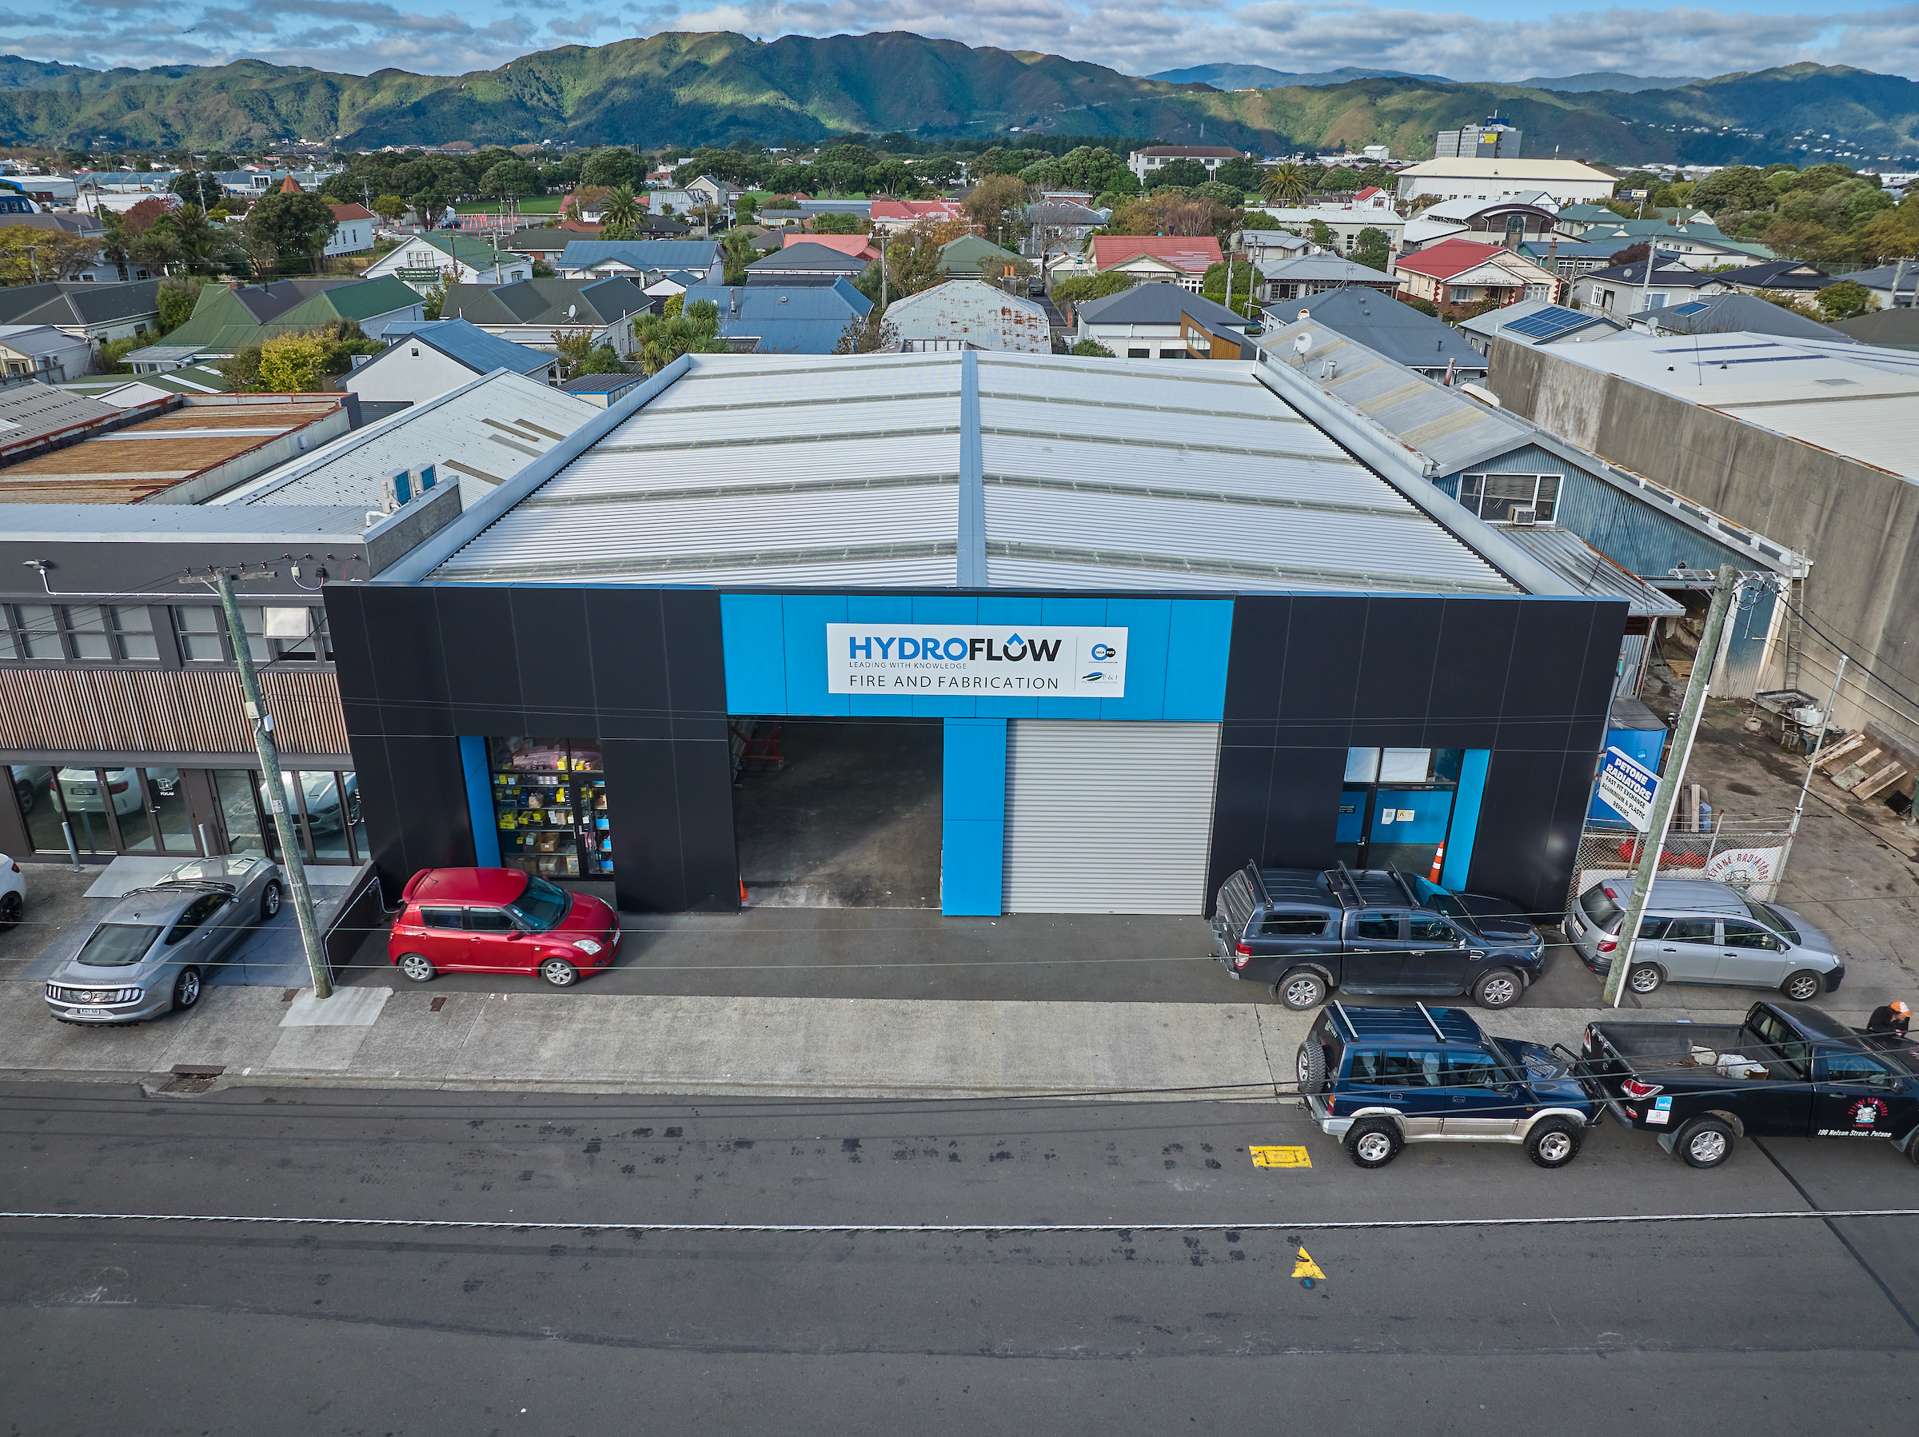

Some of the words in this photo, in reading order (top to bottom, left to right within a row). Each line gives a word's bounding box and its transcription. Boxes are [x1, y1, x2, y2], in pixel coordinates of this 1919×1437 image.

[849, 633, 1062, 661] HYDROFLOW
[849, 661, 887, 669] LEADING
[913, 662, 967, 670] KNOWLEDGE
[850, 675, 886, 687] FIRE
[893, 675, 932, 688] AND
[938, 676, 1059, 690] FABRICATION
[1606, 763, 1653, 801] RADIATORS
[1615, 757, 1649, 785] PETONE
[1605, 775, 1617, 786] FAST
[1623, 788, 1646, 809] EXCHANGE
[1628, 802, 1646, 820] PLASTIC
